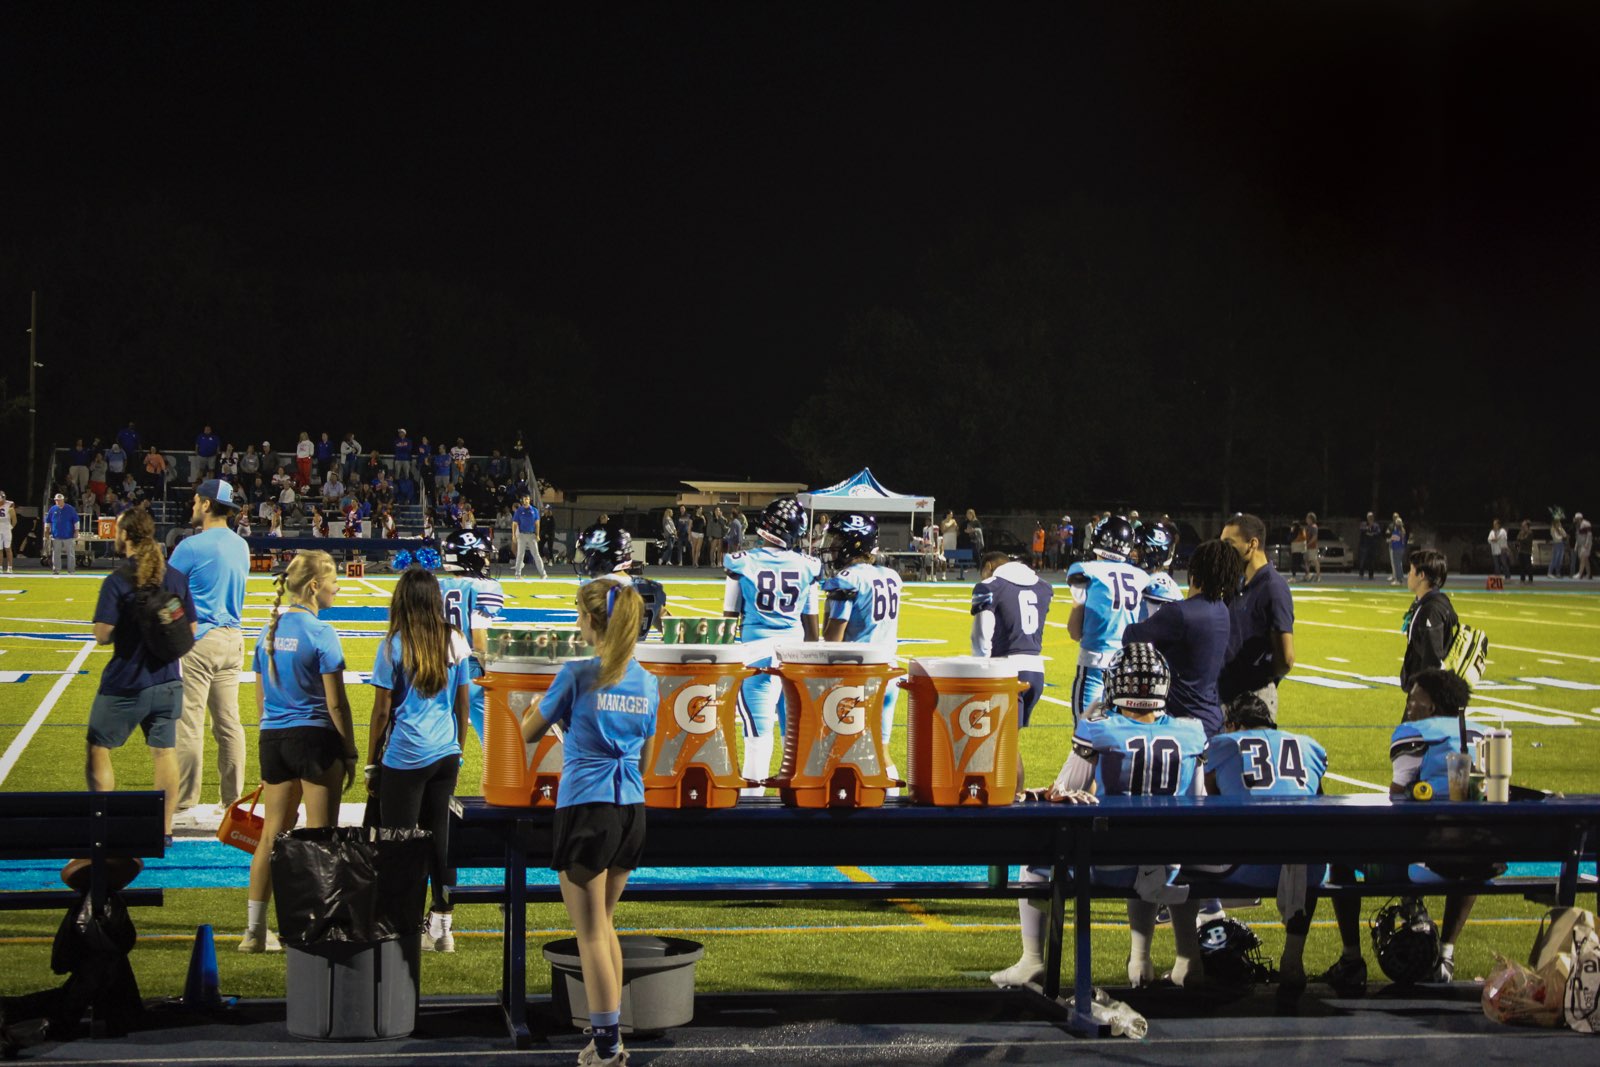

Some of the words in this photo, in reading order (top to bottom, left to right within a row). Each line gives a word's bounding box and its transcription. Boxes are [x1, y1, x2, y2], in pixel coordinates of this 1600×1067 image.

[459, 532, 477, 546] B
[850, 514, 865, 527] B
[347, 564, 362, 577] 50
[755, 569, 801, 613] 85
[1107, 570, 1139, 611] 15
[872, 576, 899, 622] 66
[1018, 589, 1039, 635] 6
[597, 693, 649, 715] MANAGER
[673, 684, 717, 735] G
[822, 685, 865, 735] G
[958, 699, 991, 738] G
[1125, 699, 1159, 708] Riddell
[1126, 735, 1182, 797] 10
[1237, 736, 1308, 790] 34
[1207, 925, 1228, 945] B
